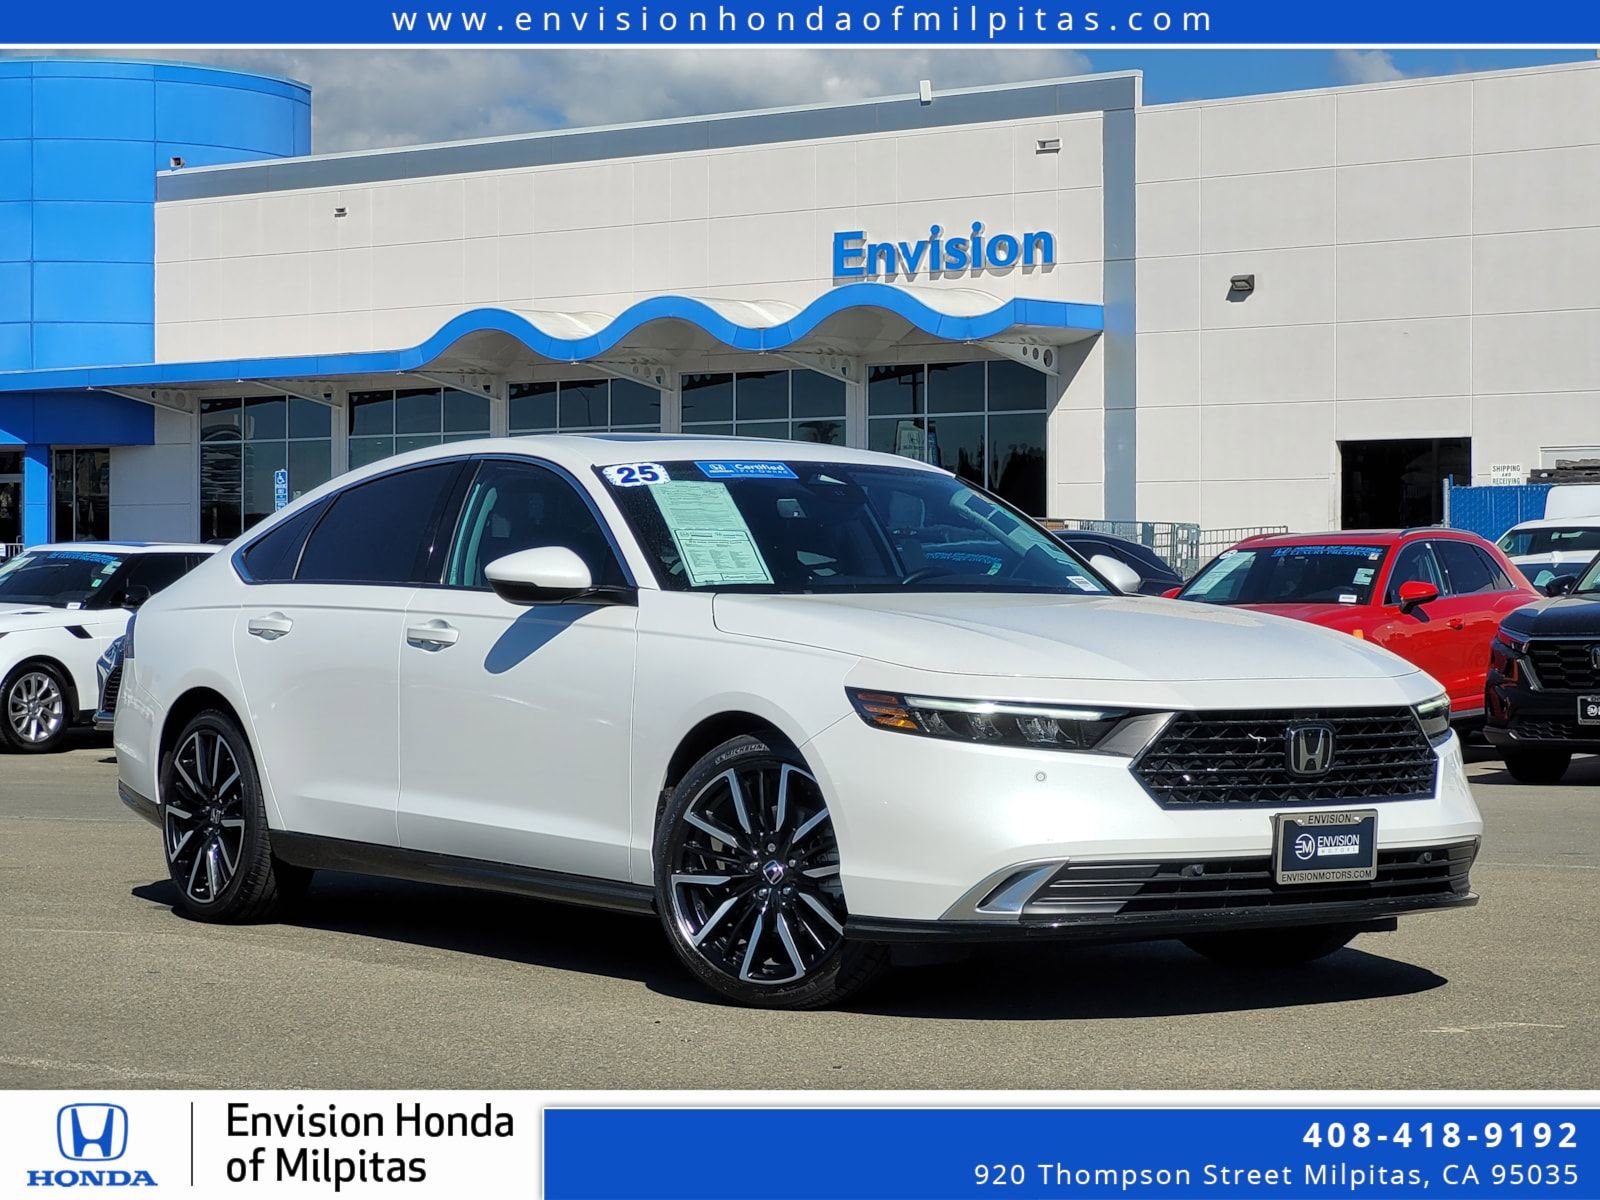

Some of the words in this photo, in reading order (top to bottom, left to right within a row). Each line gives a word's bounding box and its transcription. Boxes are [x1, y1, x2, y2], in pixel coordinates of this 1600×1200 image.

[833, 221, 1054, 277] Envision
[735, 463, 785, 471] Certified
[617, 466, 659, 484] 25
[1492, 477, 1520, 485] RECEIVING
[1308, 814, 1351, 824] ENVISION
[1317, 834, 1359, 847] ENVISION
[1281, 870, 1372, 882] ENVISIONMOTORS.COM
